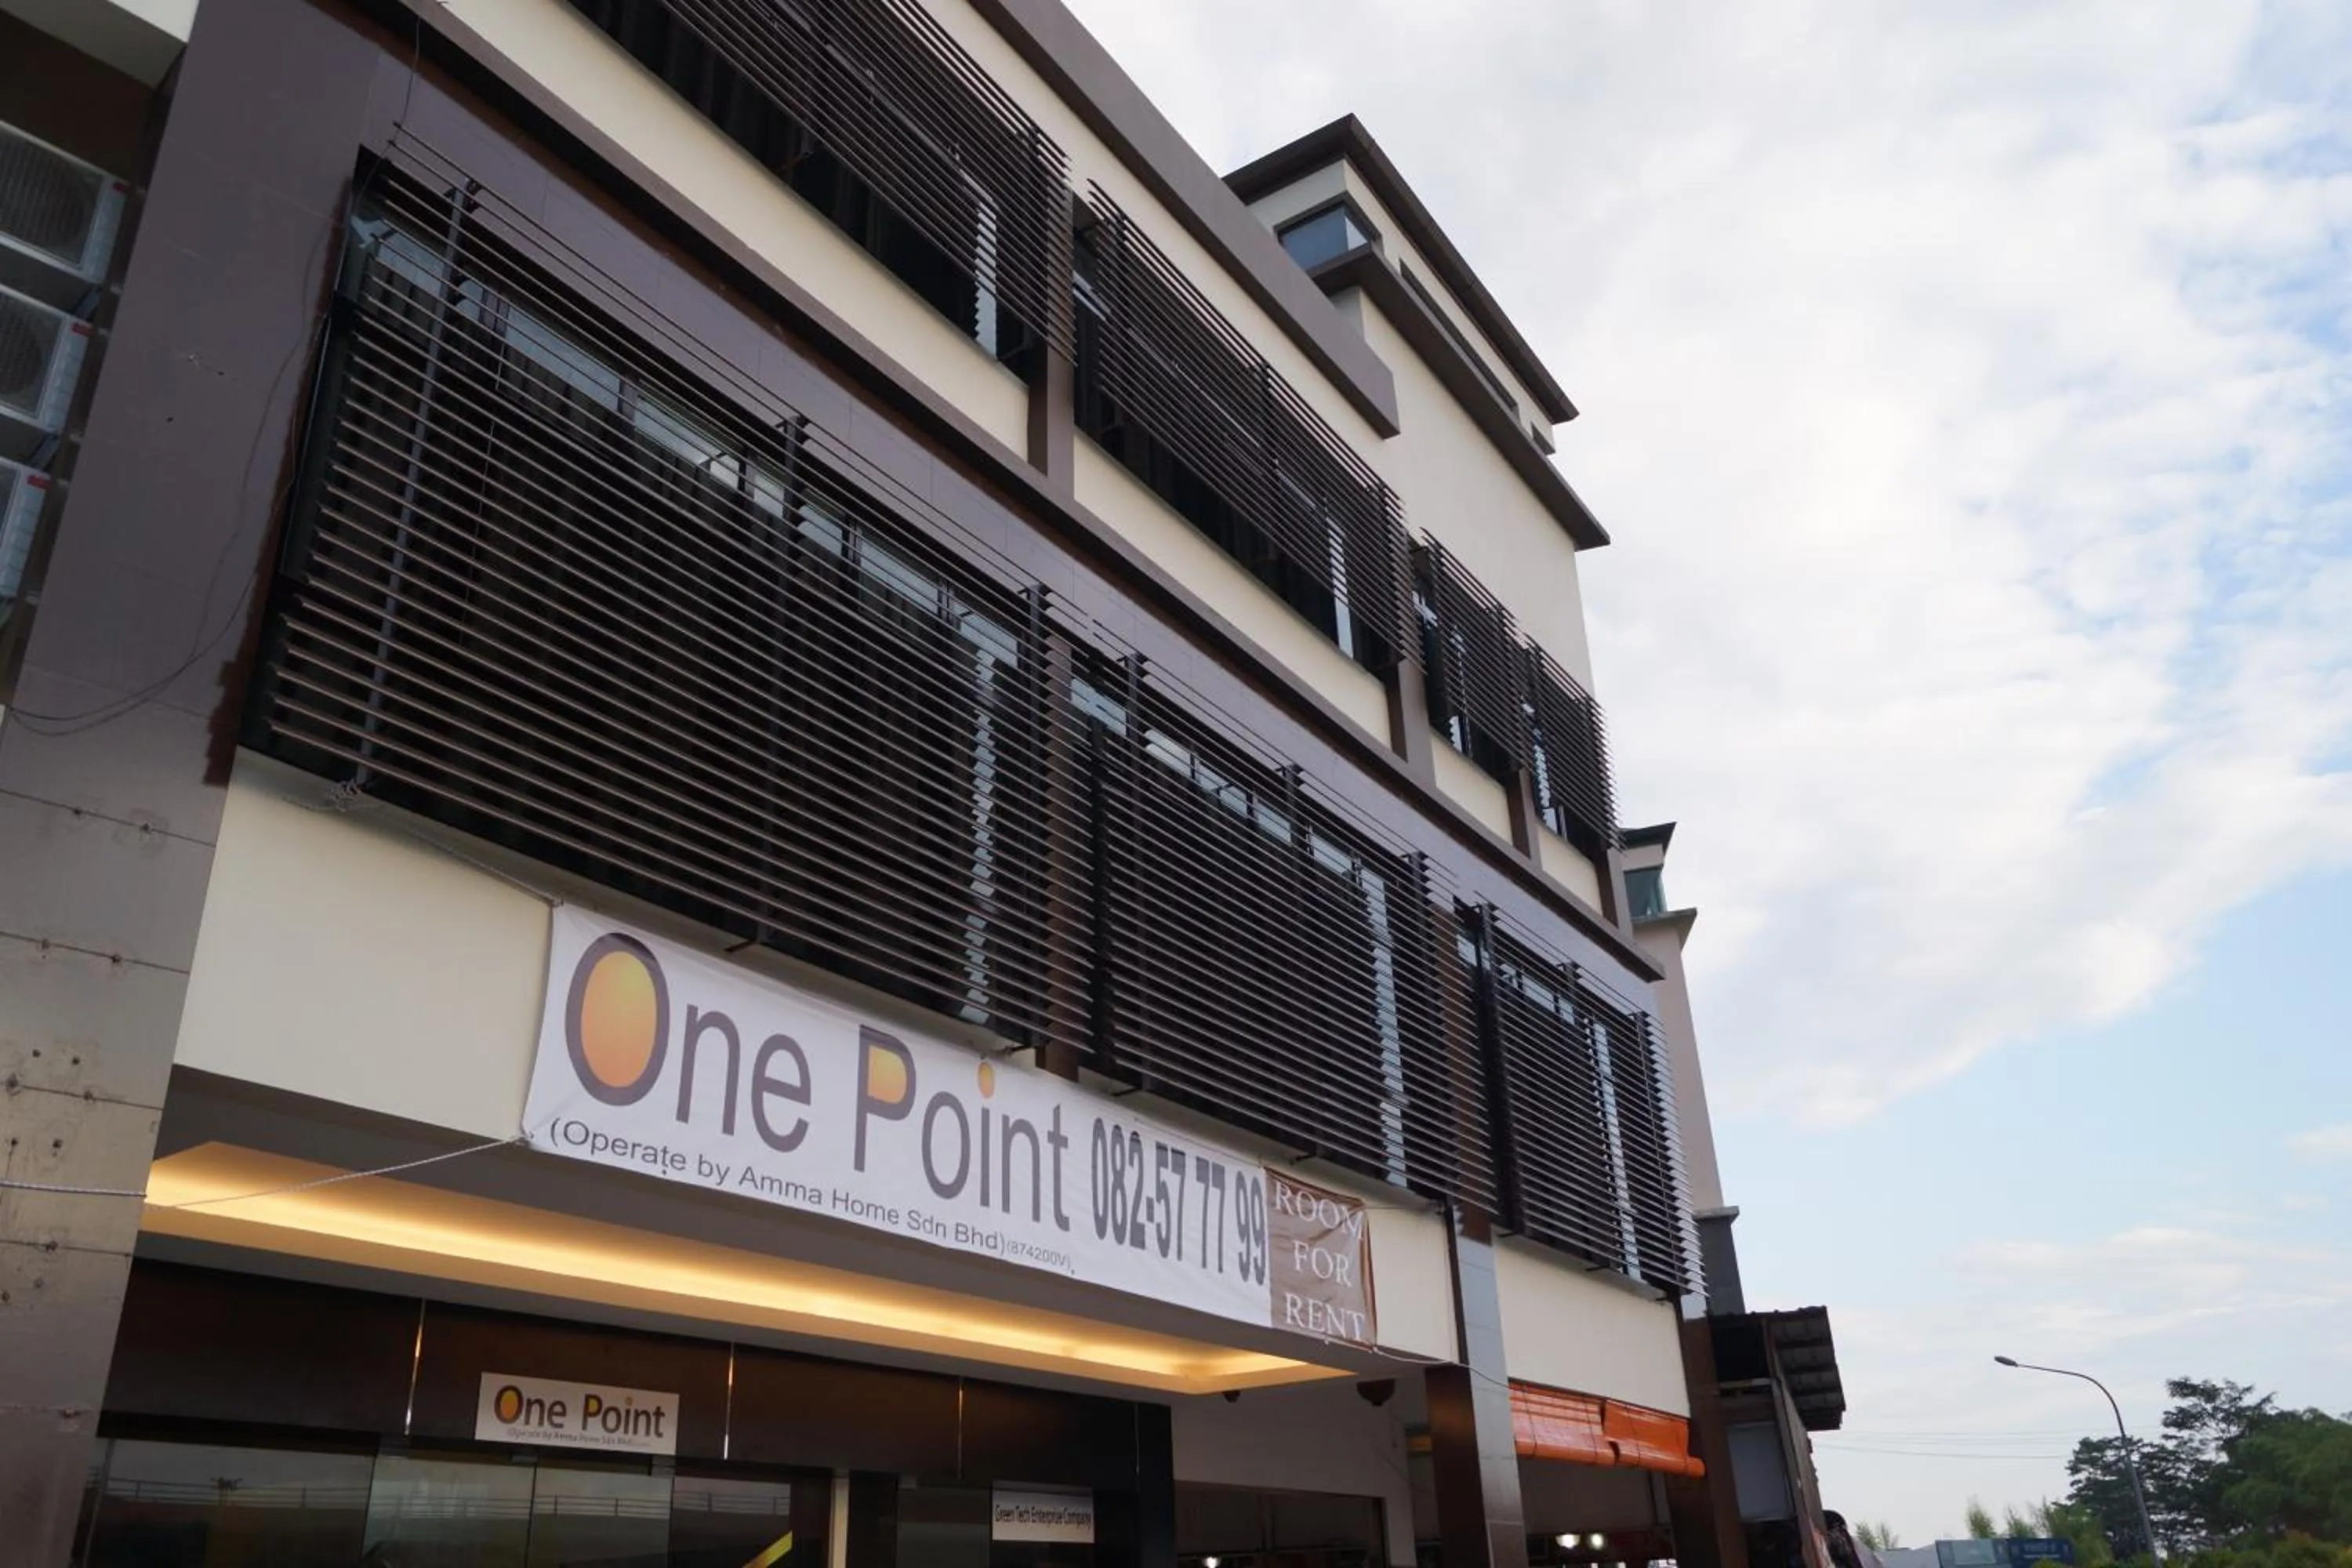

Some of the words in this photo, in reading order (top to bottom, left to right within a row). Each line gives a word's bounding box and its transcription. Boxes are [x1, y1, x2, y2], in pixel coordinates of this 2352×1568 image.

[564, 931, 811, 1153] One
[854, 1024, 1070, 1232] Point
[1091, 1116, 1186, 1261] 082-57
[1196, 1156, 1225, 1273] 77
[1235, 1171, 1266, 1286] 99
[550, 1117, 687, 1171] (Operate
[698, 1153, 731, 1186] by
[739, 1166, 822, 1205] Amma
[832, 1188, 899, 1225] Home
[906, 1209, 946, 1239] Sdn
[1275, 1181, 1364, 1242] ROOM
[1294, 1240, 1352, 1287] FOR
[1284, 1292, 1366, 1342] RENT
[494, 1385, 567, 1429] One
[582, 1393, 666, 1438] Point
